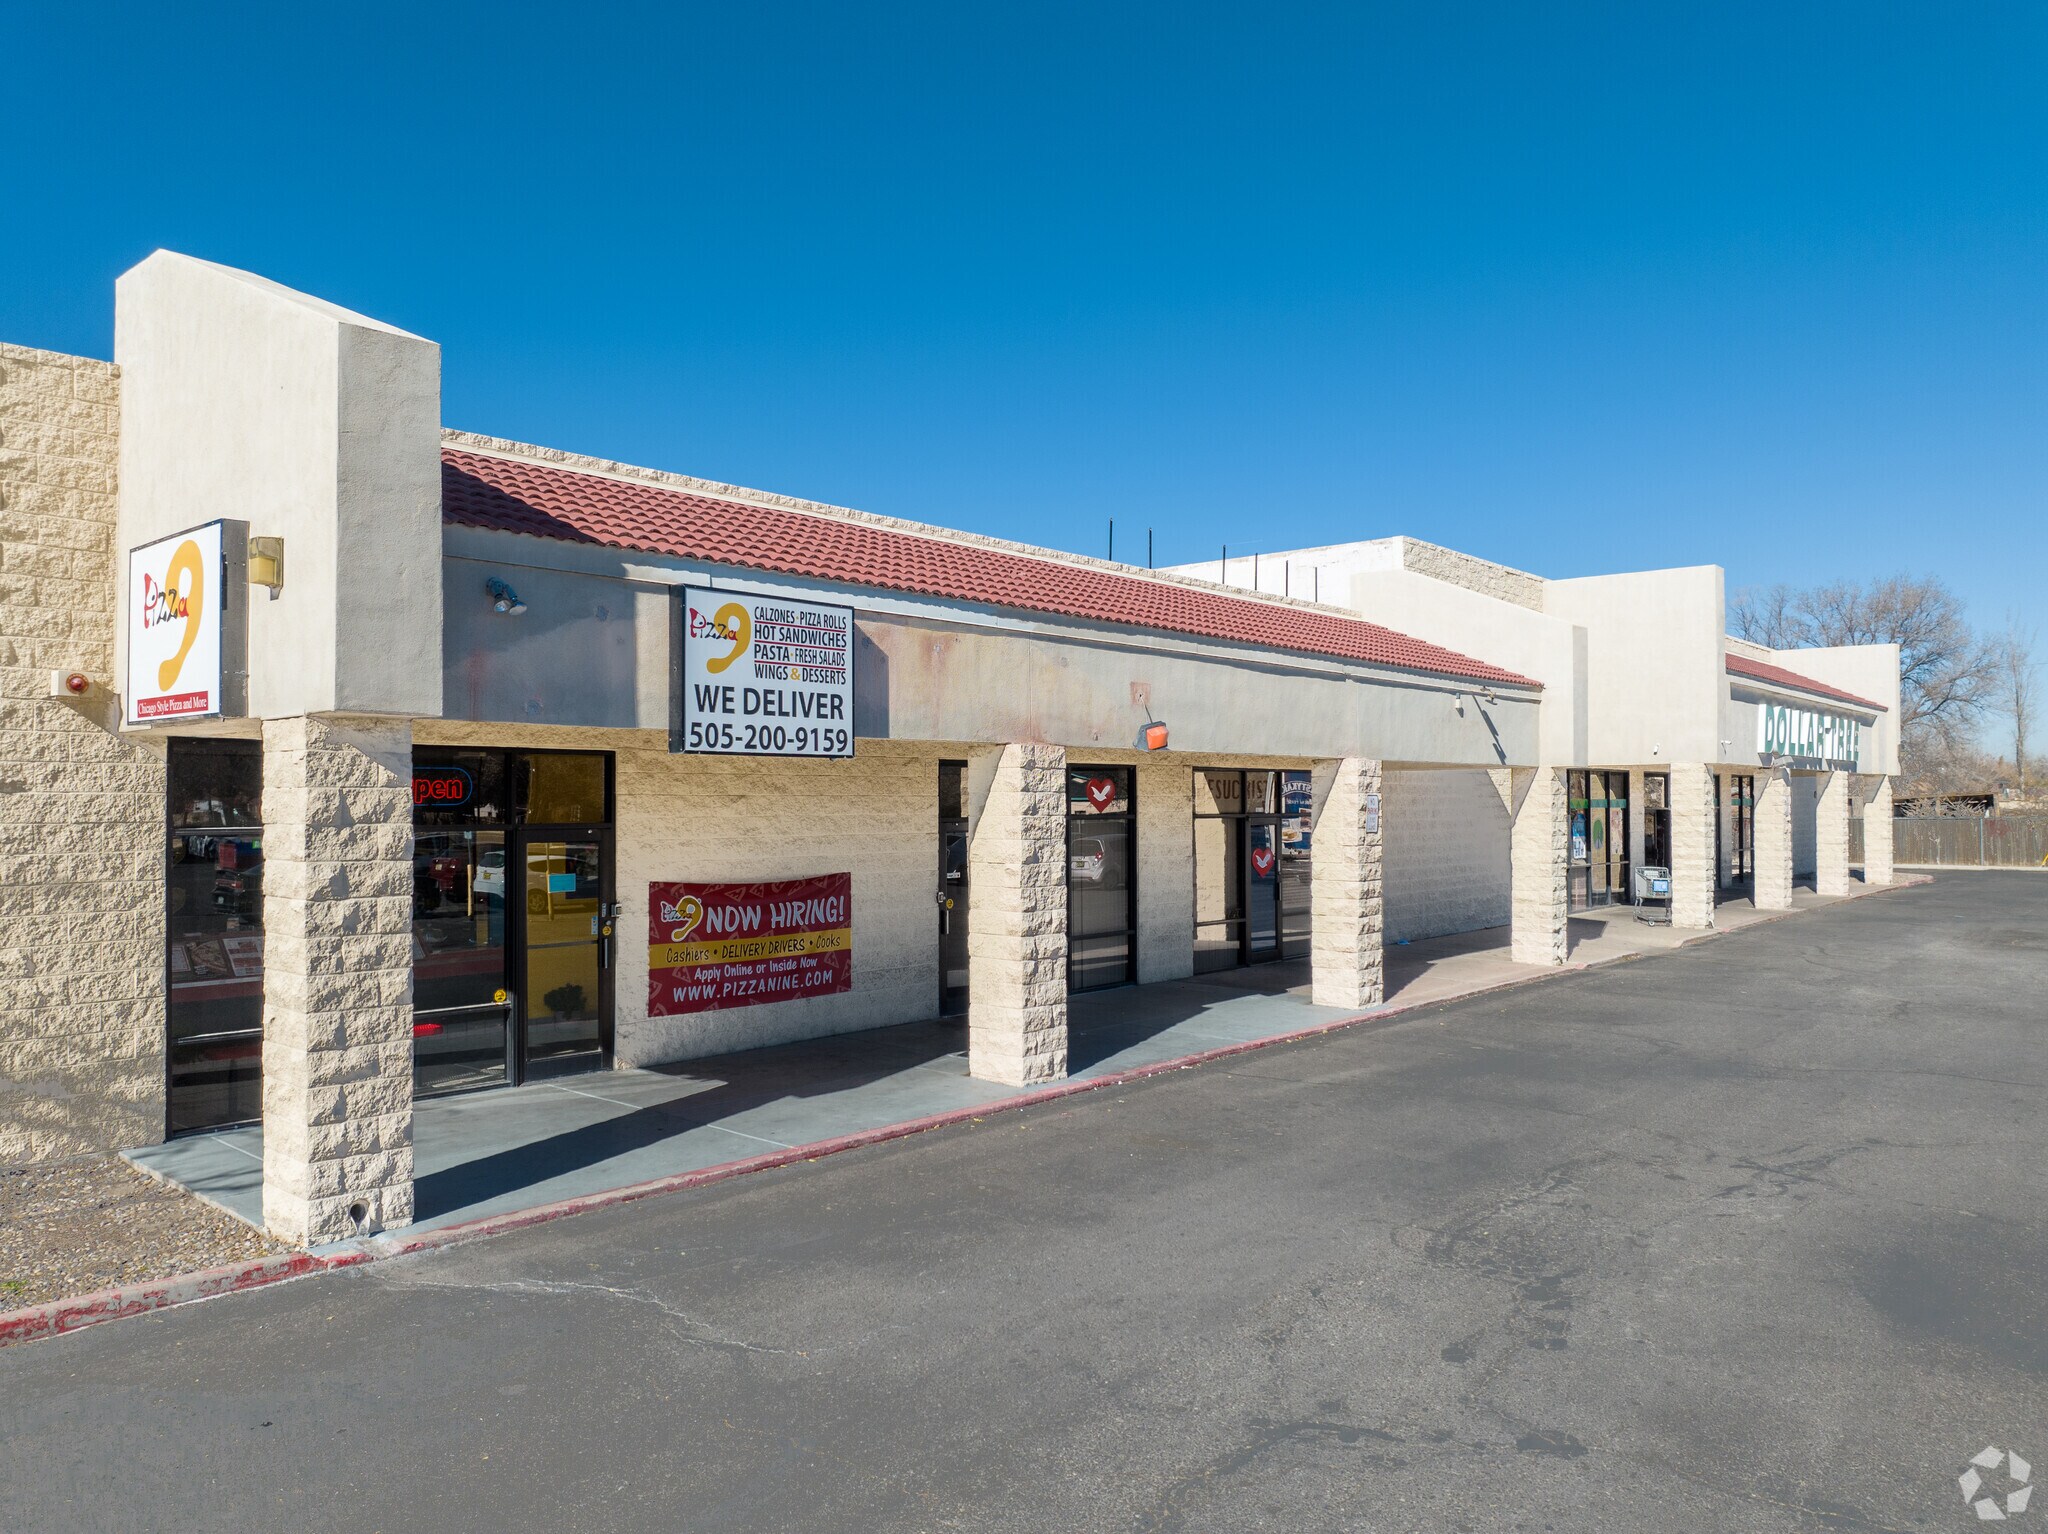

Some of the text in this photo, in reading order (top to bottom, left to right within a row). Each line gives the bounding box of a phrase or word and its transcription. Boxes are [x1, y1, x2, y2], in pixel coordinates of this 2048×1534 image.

[144, 572, 189, 629] Pizza
[689, 607, 738, 641] Pizza
[754, 606, 847, 630] CALZONES PIZZA ROLLS
[754, 624, 847, 648] HOT SANDWICHES
[754, 644, 845, 667] PASTA FRESH SALADS
[754, 664, 846, 685] WINGS & DESSERTS
[138, 696, 207, 716] Chicago Style Pizza and More
[694, 684, 844, 720] WE DELIVER
[689, 721, 848, 753] 505-200-9159
[1758, 704, 1860, 762] DOLLAR TREE
[412, 779, 463, 804] pen
[706, 895, 845, 933] NOW HIRING!
[666, 934, 841, 964] Cashiers DELIVERY DRIVERS Cooks
[694, 956, 818, 983] Apply Online or Inside Now
[673, 969, 833, 1003] WWW.PIZZANINE.COM
